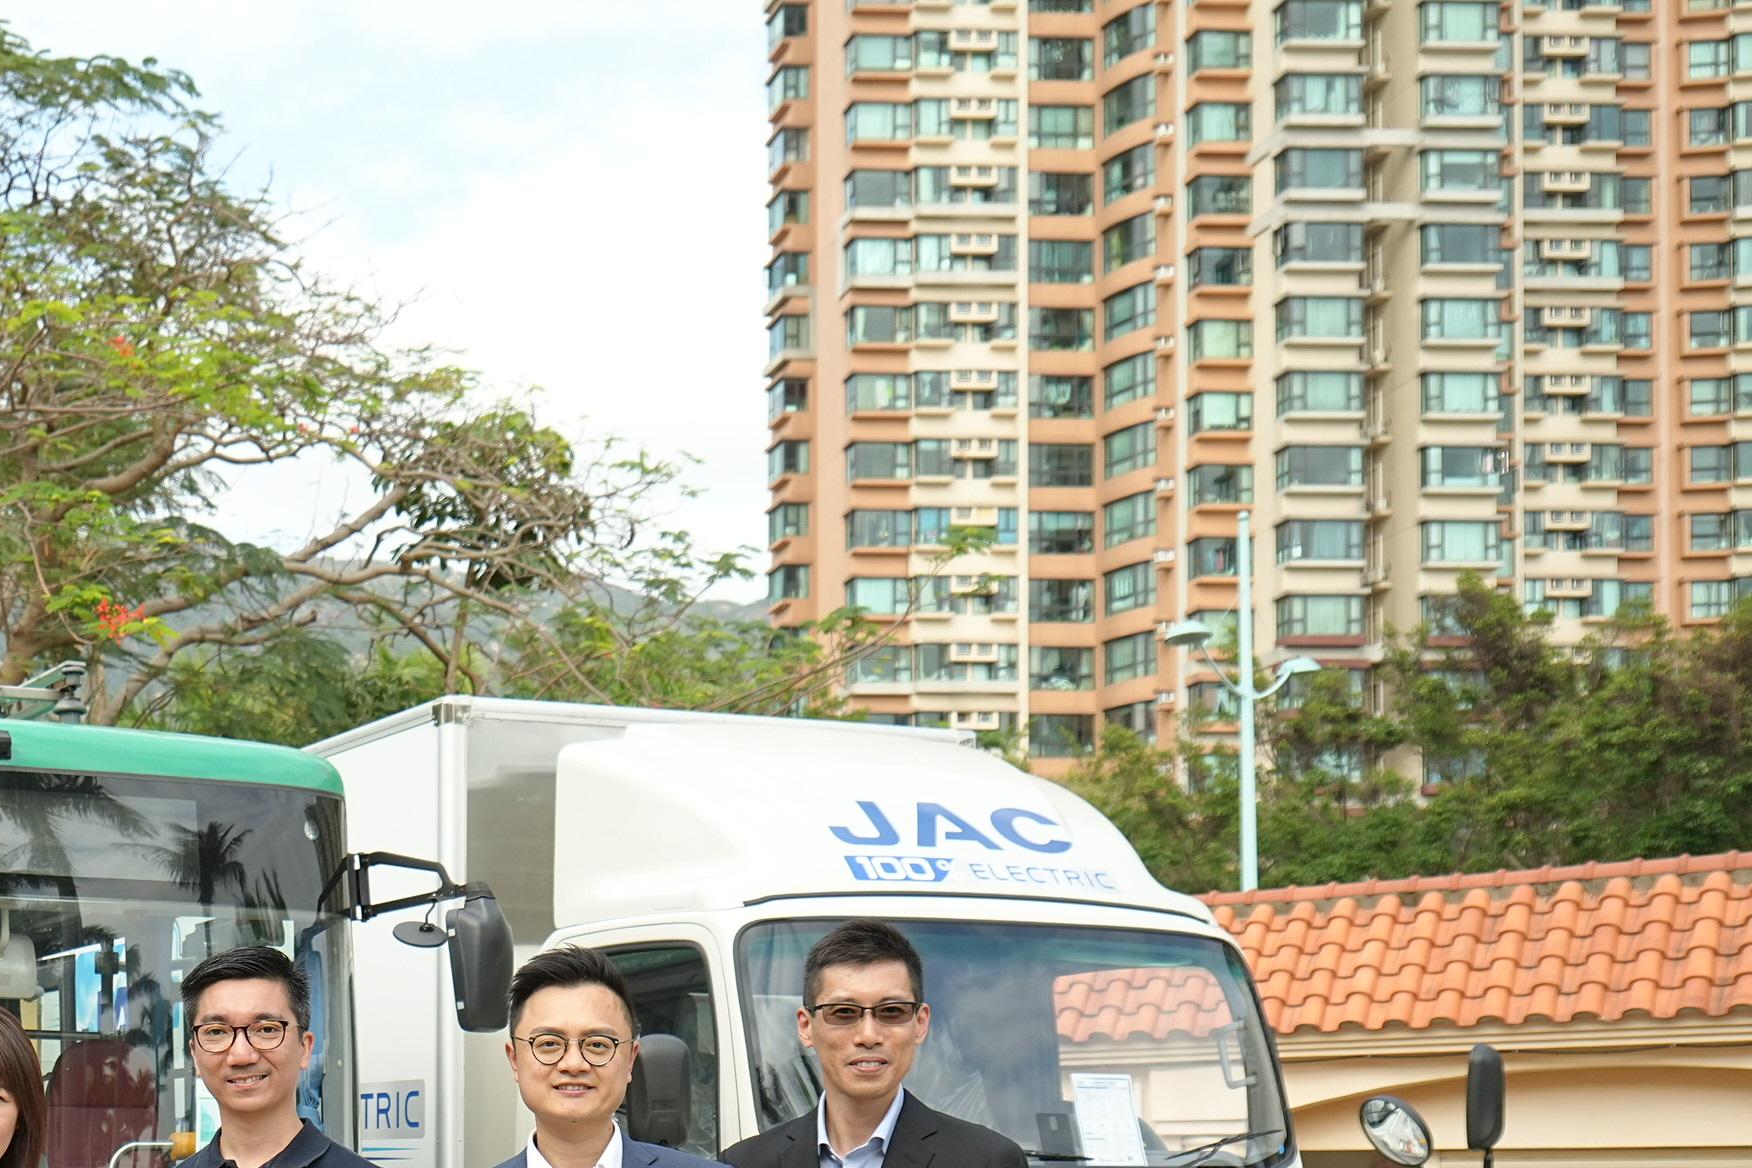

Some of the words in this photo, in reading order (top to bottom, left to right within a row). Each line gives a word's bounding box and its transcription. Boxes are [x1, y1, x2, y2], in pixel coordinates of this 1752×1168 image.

[828, 800, 1073, 854] JAC
[968, 863, 1116, 890] ELECTRIC
[360, 1090, 420, 1130] TRIC
